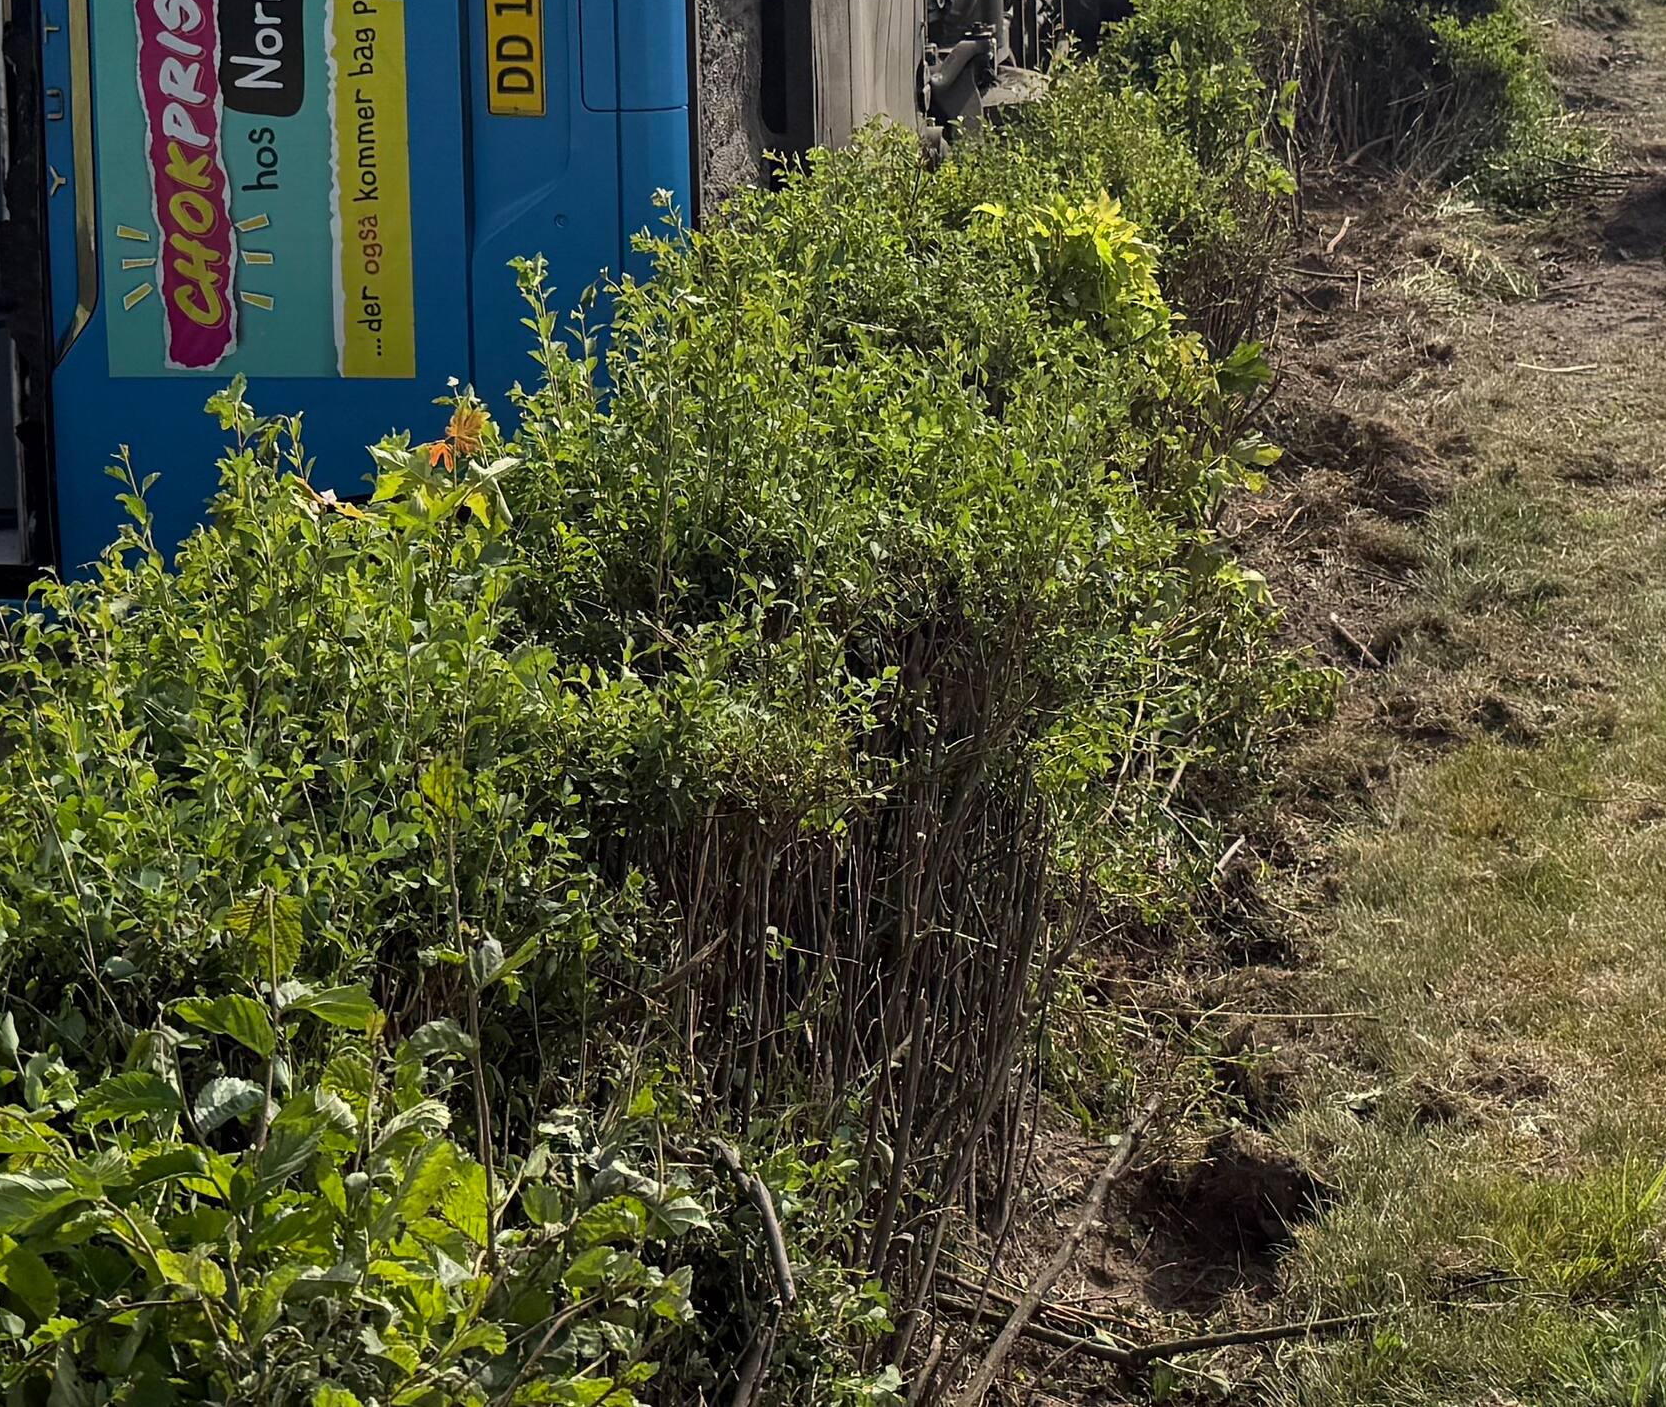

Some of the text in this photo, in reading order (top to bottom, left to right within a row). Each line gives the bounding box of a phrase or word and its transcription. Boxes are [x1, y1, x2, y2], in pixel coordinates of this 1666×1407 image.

[347, 27, 376, 78] bag
[496, 34, 535, 95] DD
[241, 126, 279, 192] hos
[353, 87, 379, 202] kommer
[358, 213, 383, 275] også
